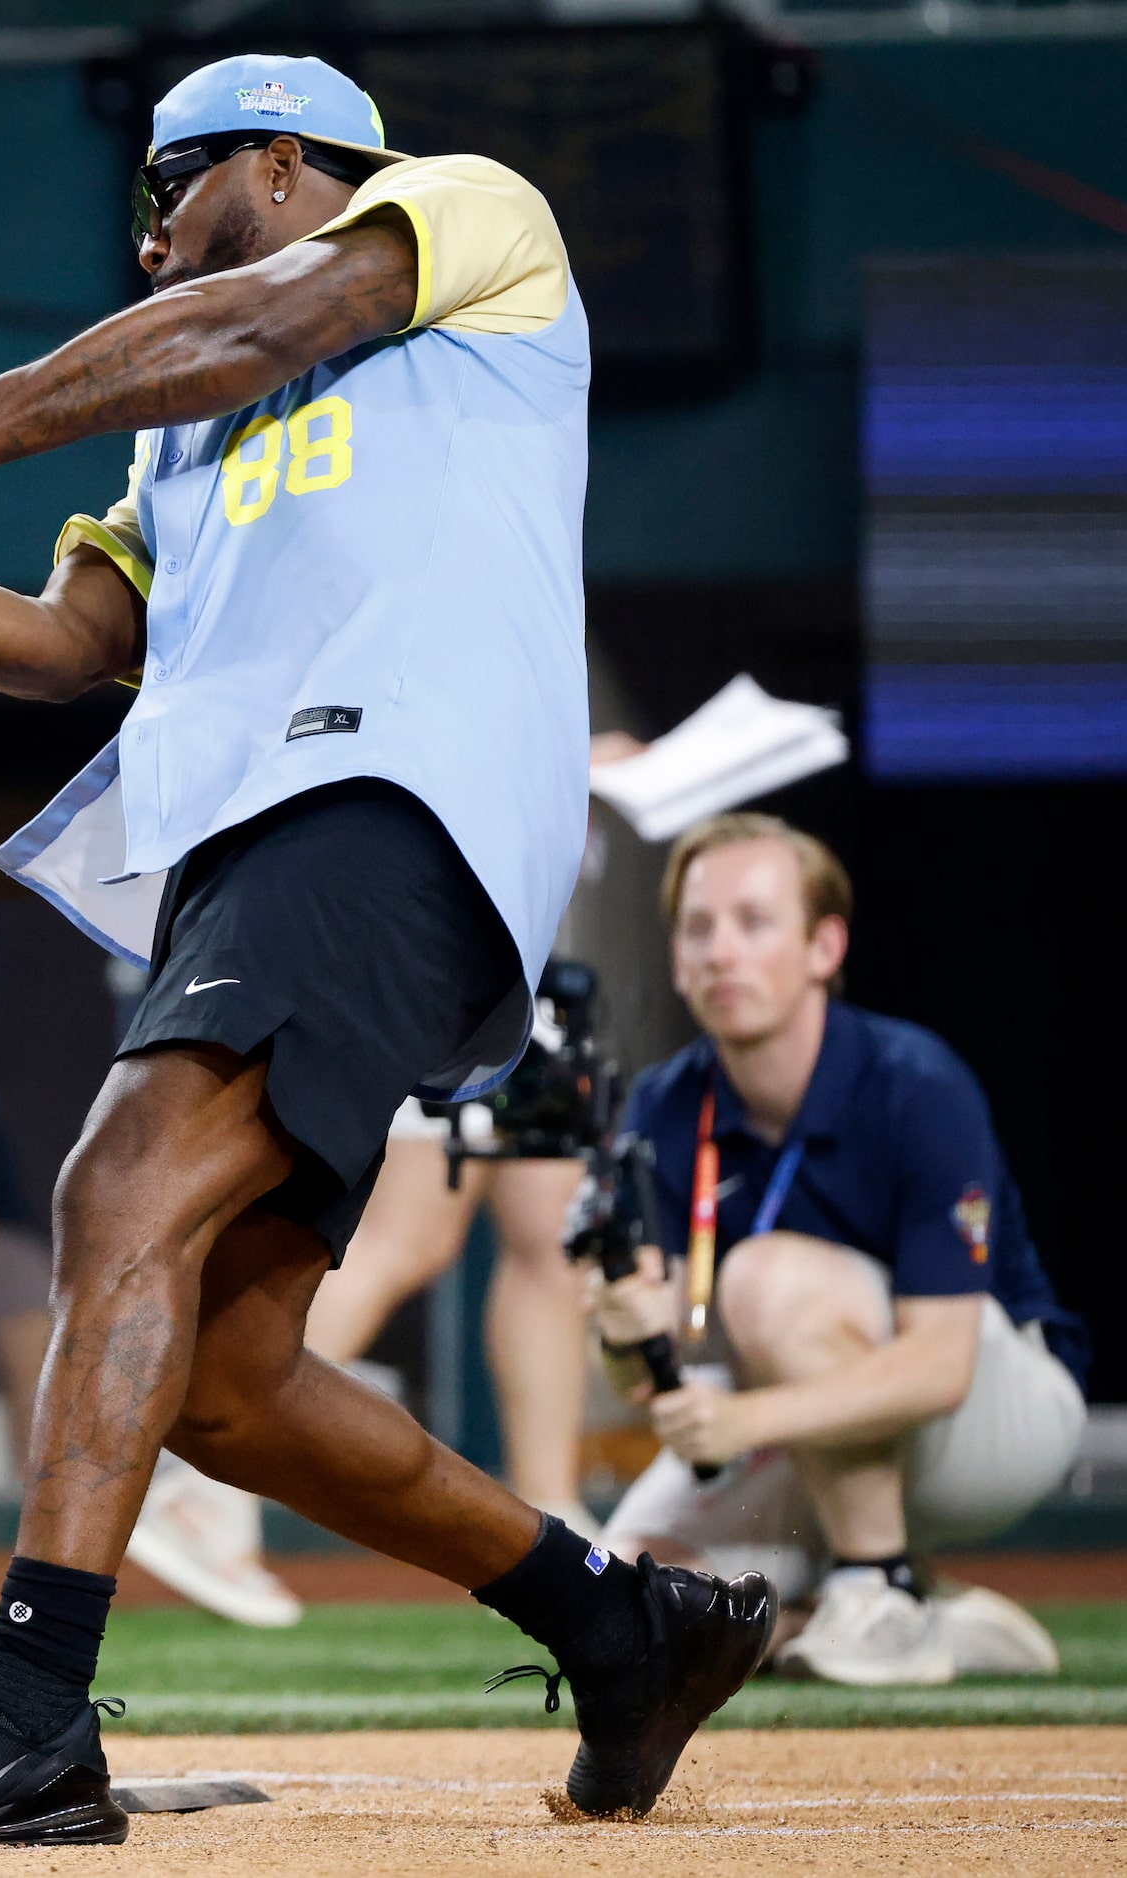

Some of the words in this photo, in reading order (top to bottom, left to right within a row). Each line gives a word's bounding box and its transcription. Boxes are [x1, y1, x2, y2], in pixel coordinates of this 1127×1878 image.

[239, 95, 304, 109] CELEBRITY
[221, 395, 352, 527] 88
[333, 712, 350, 725] XL
